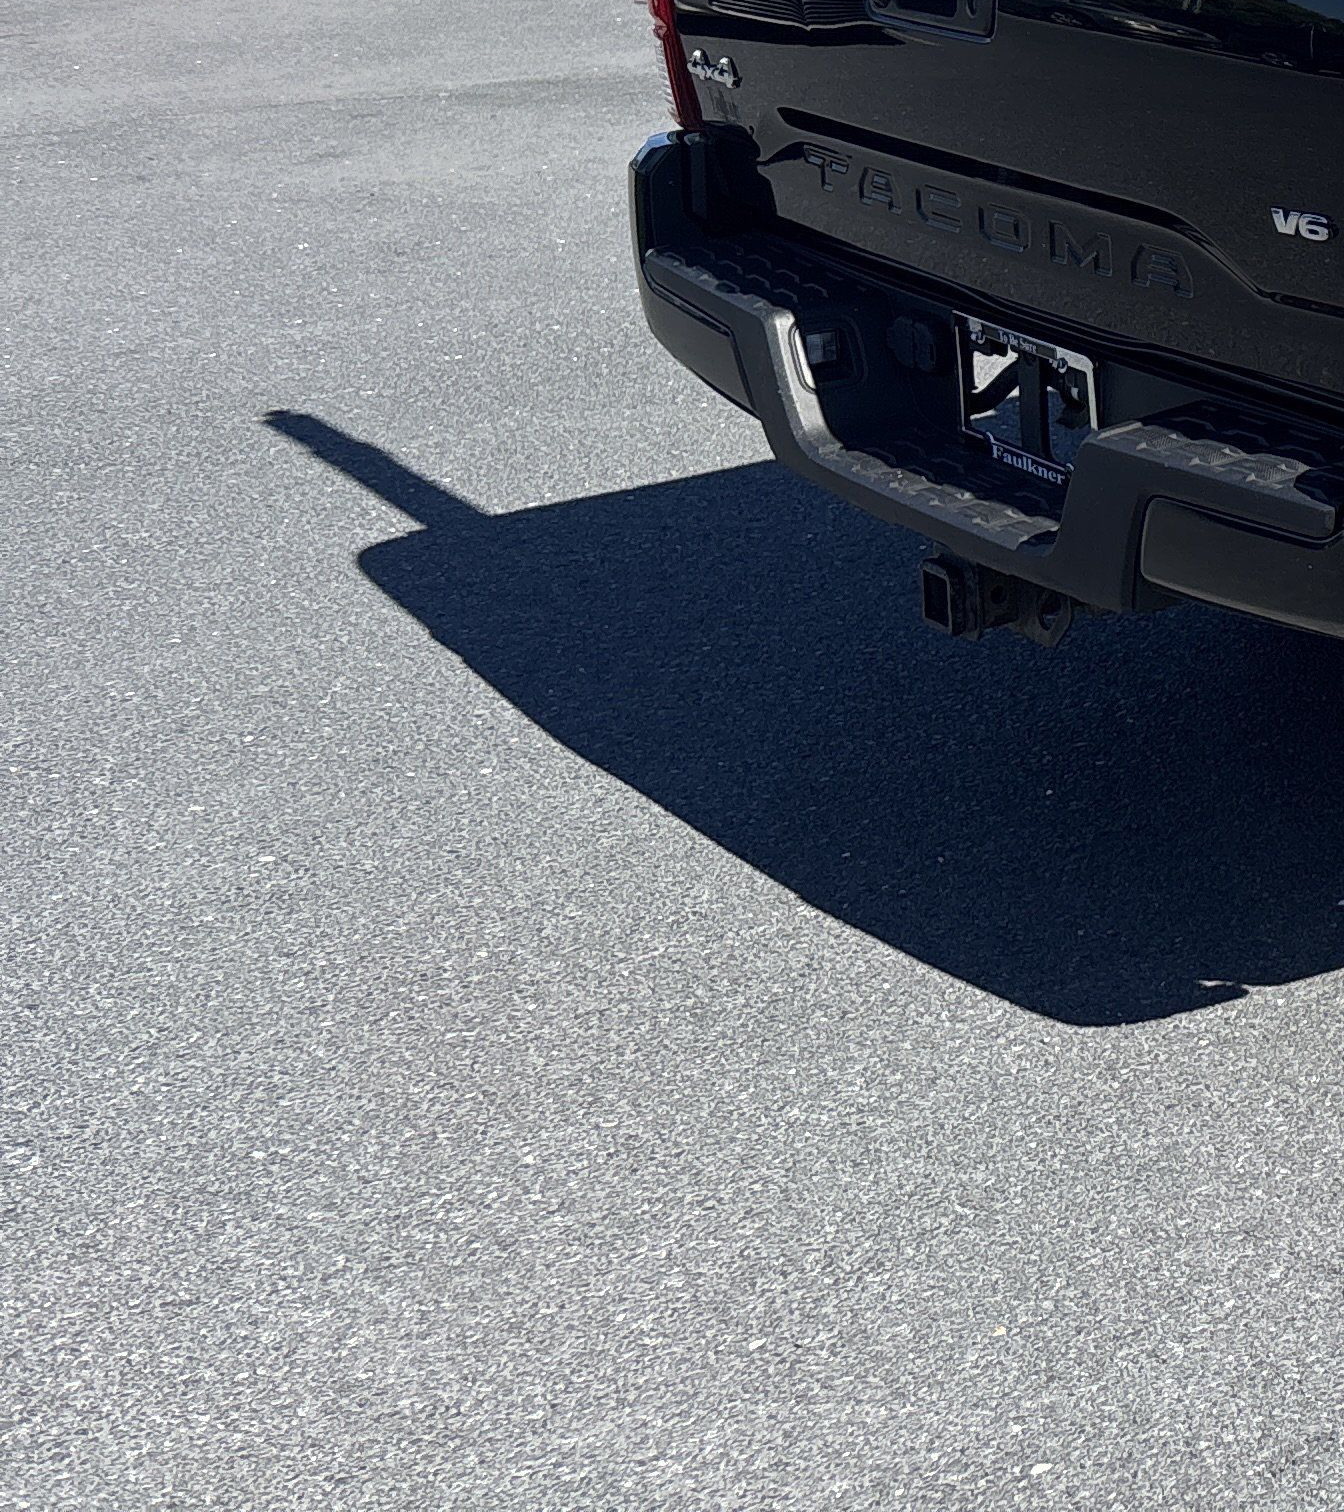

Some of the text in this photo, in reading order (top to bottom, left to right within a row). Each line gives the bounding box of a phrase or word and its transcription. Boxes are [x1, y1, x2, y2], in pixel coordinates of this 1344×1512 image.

[803, 143, 1195, 299] TACOMA
[1270, 207, 1330, 242] V6
[992, 444, 1066, 485] Faulkner
